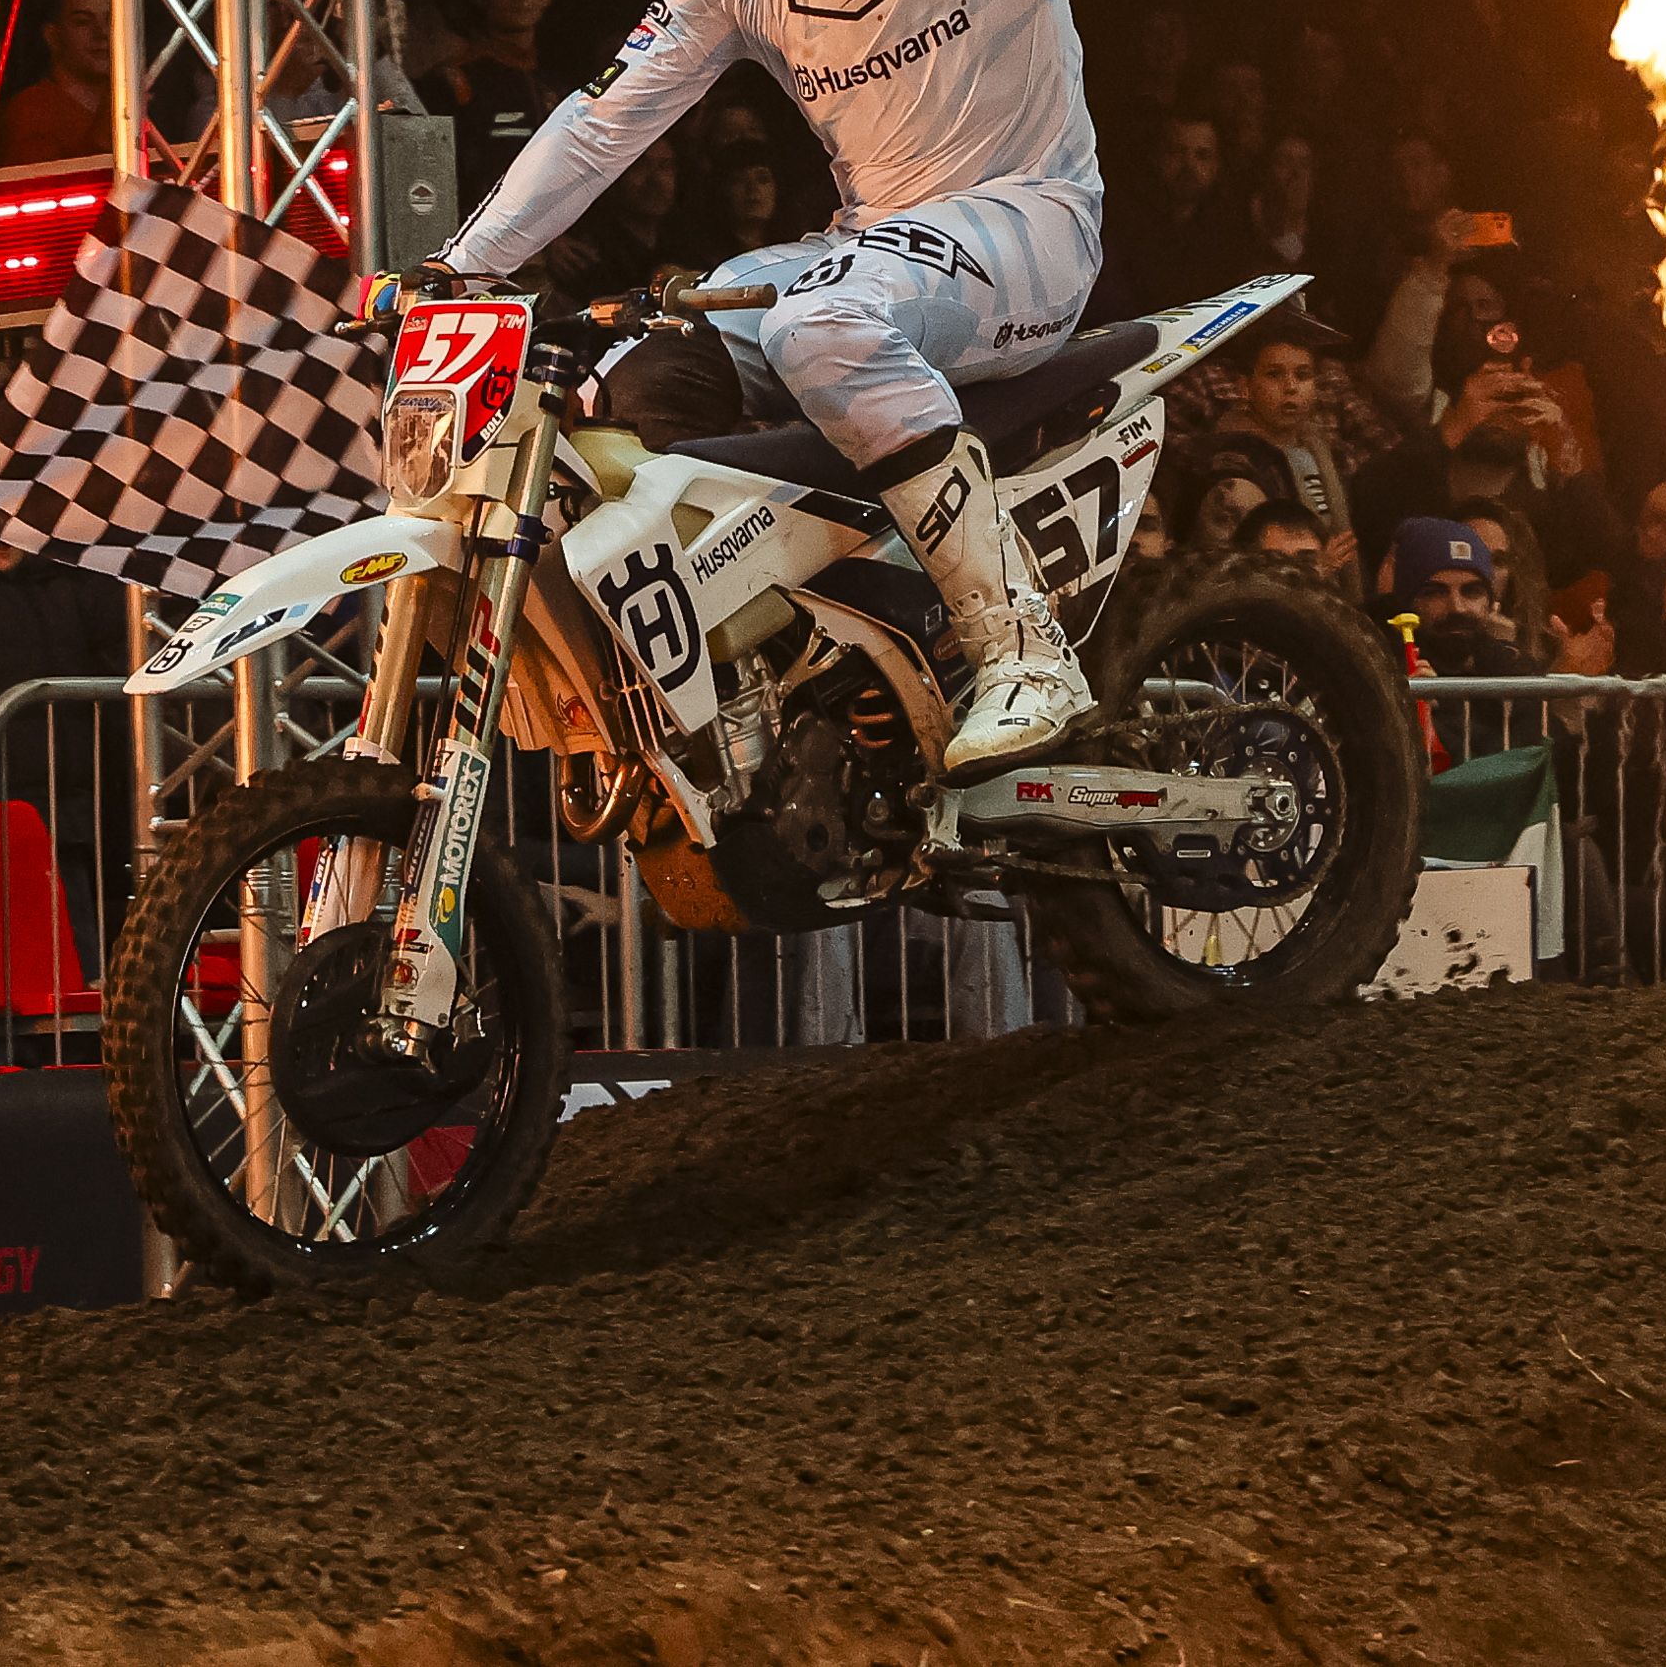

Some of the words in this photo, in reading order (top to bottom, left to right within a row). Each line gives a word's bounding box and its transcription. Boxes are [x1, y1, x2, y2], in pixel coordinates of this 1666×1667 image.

[812, 7, 971, 95] Husqvarna
[401, 312, 500, 383] 57
[479, 408, 506, 442] BOLT
[1117, 415, 1152, 446] FIM
[689, 505, 777, 586] Husqvarna
[1009, 455, 1121, 595] 57
[439, 766, 483, 885] MOTOREX
